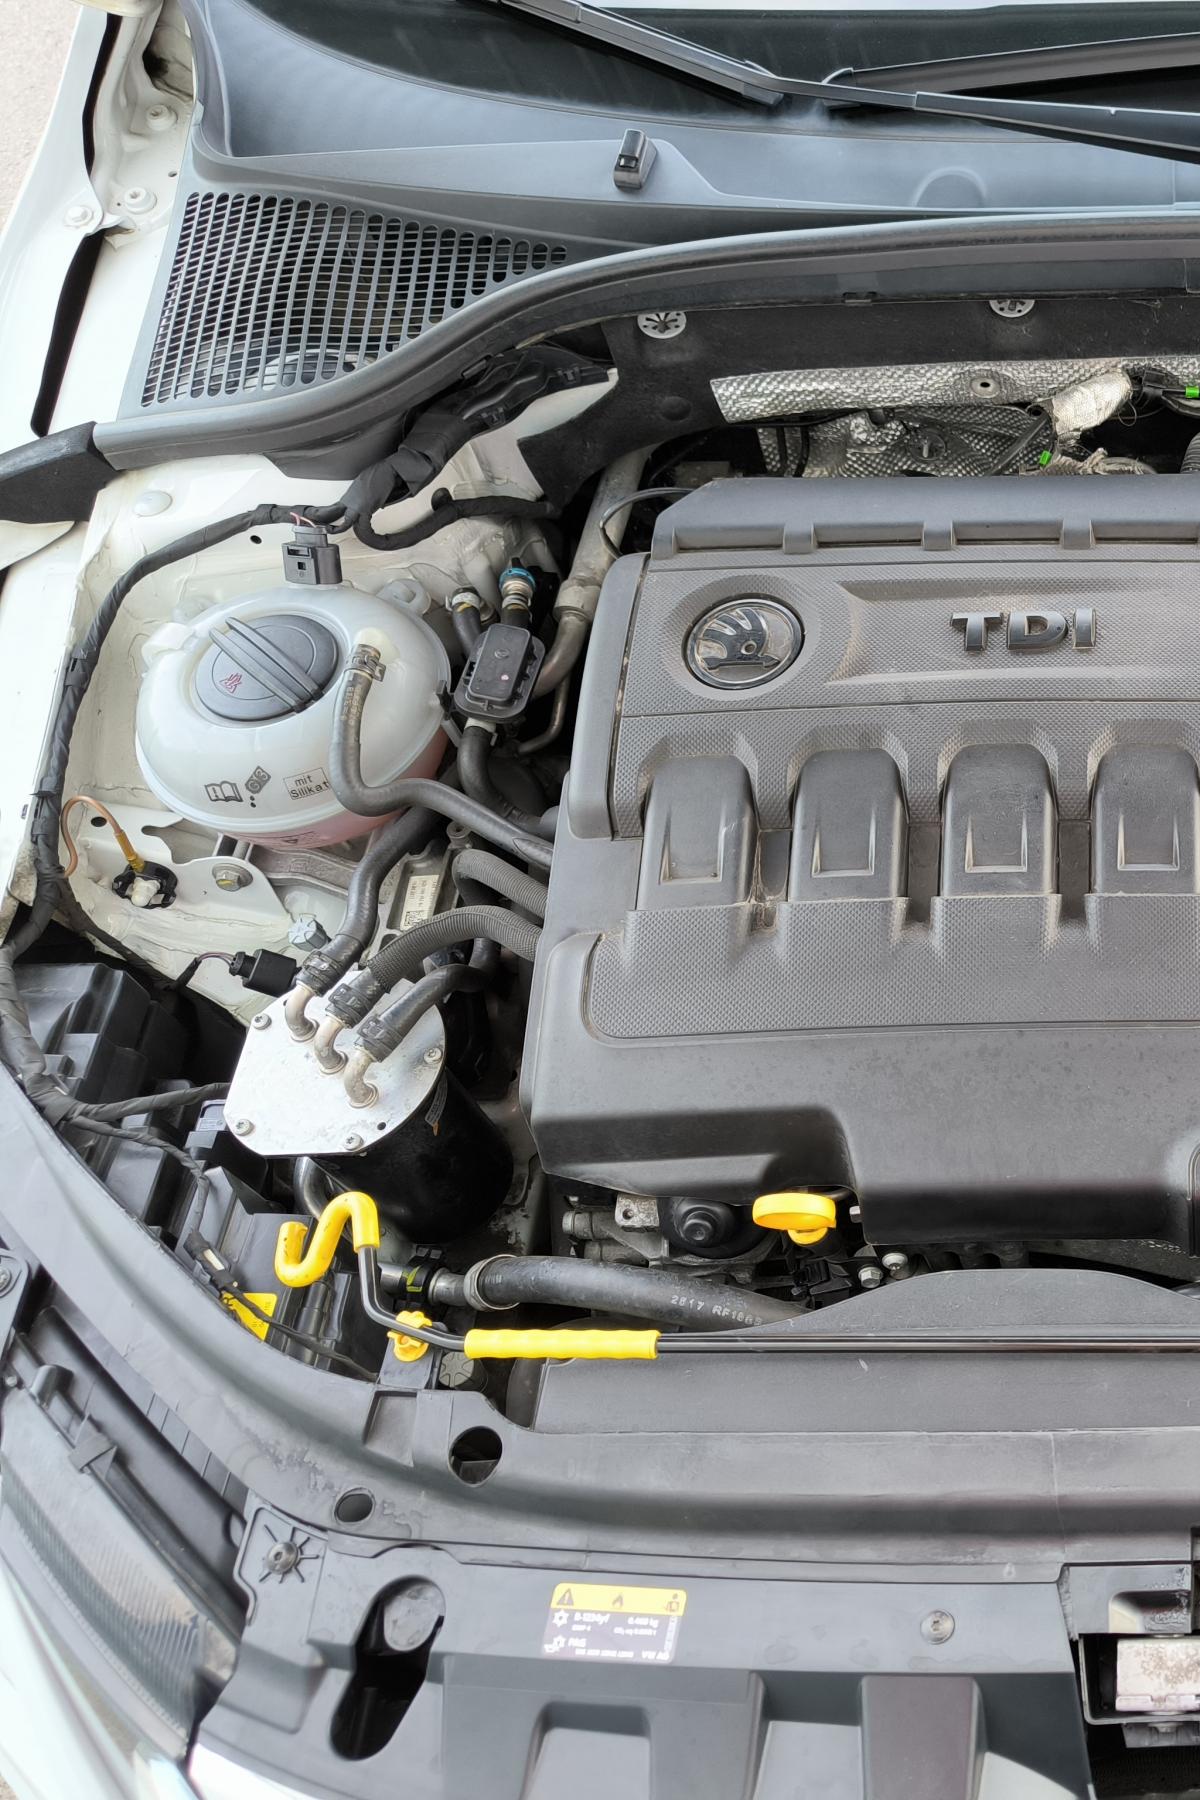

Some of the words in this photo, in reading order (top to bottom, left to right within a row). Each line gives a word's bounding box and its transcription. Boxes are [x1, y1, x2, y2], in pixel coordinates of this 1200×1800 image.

[950, 607, 1097, 652] TDI
[294, 774, 312, 787] mit
[290, 781, 329, 798] Silikat
